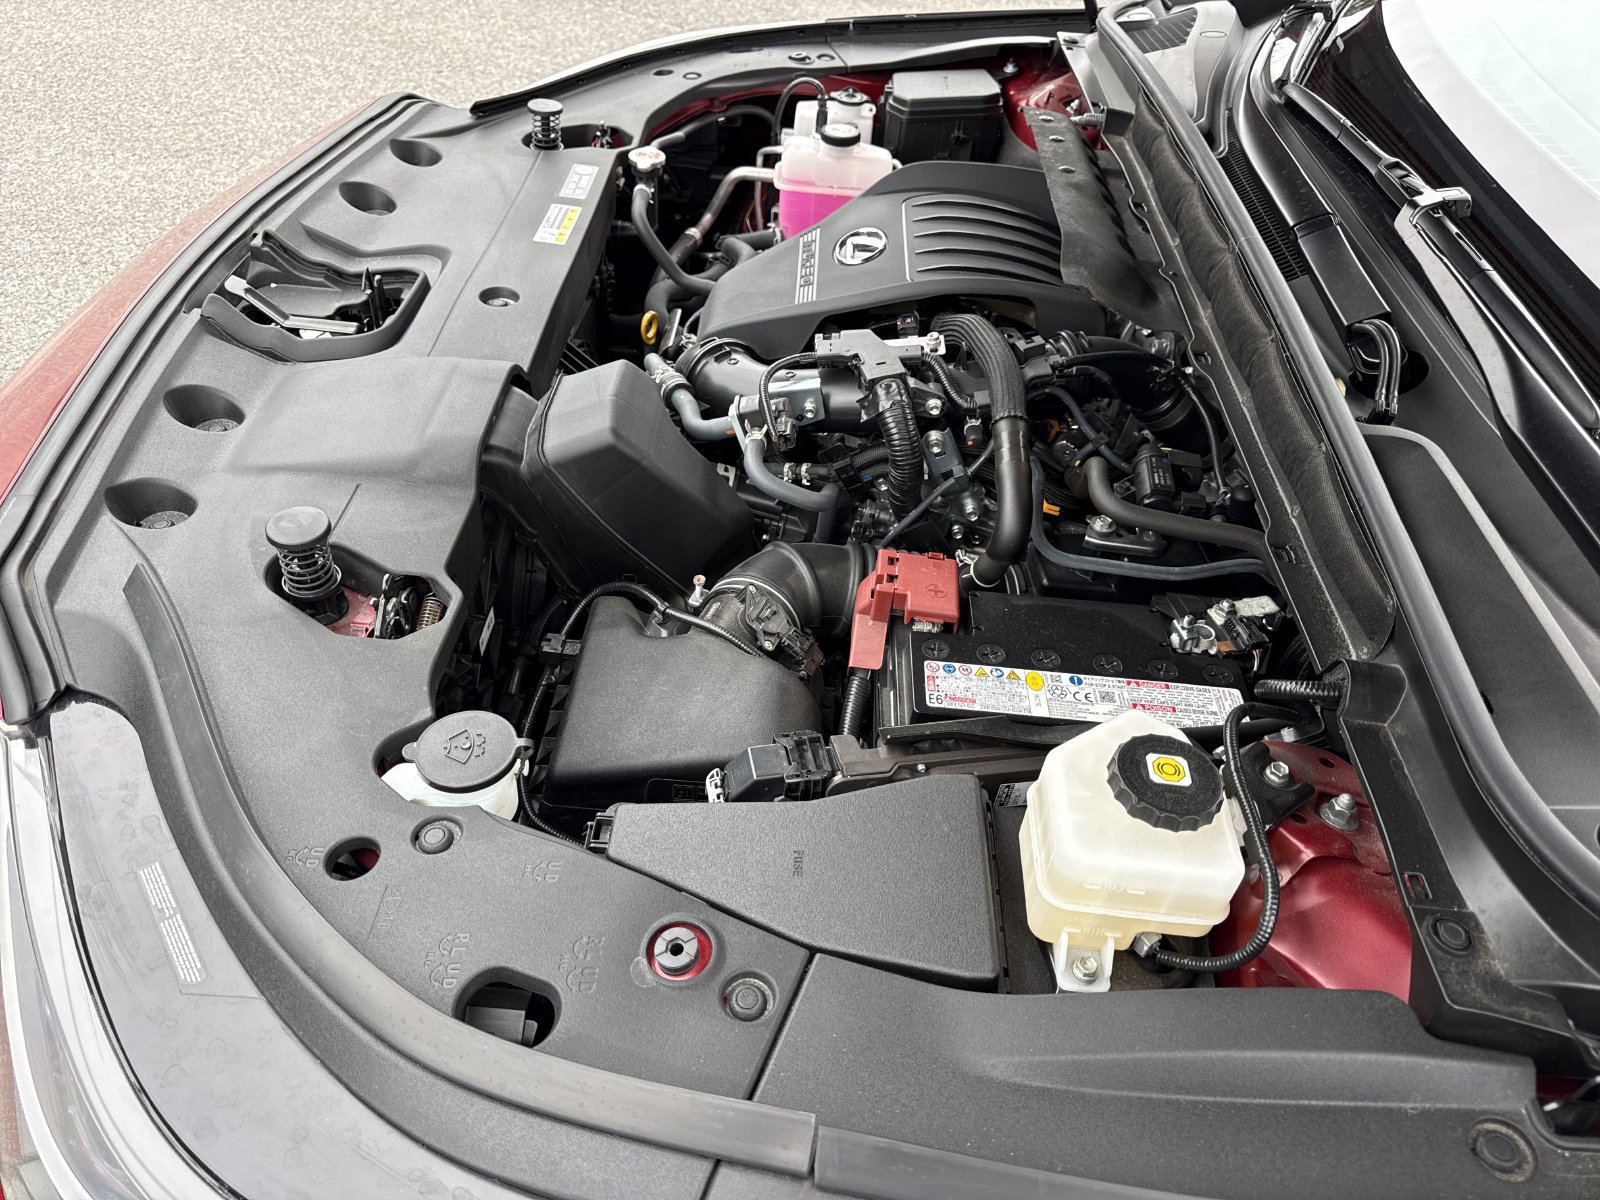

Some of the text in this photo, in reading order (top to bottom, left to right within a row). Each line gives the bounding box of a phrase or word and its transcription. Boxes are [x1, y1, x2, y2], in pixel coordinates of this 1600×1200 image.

[1139, 681, 1166, 690] DANGER
[1170, 684, 1196, 692] EXPLOSIVE
[928, 693, 944, 704] E6
[1144, 705, 1173, 713] POISON
[793, 850, 804, 876] FUSE
